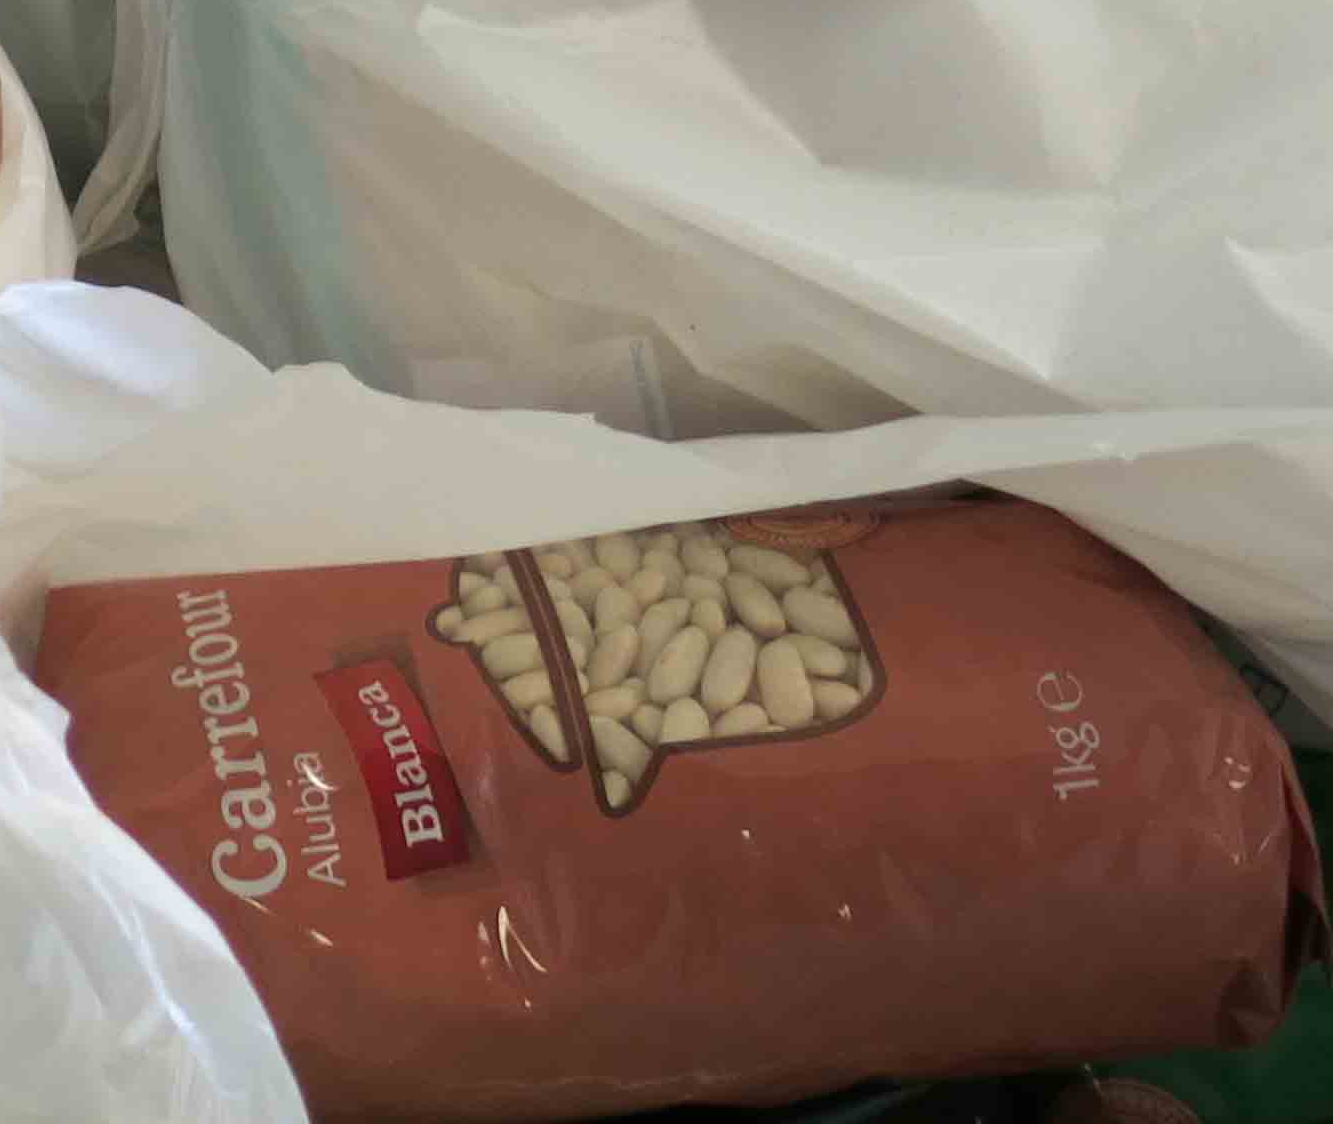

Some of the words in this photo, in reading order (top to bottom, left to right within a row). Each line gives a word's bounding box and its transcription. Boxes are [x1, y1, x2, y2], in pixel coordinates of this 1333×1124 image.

[171, 588, 289, 898] Carrefour
[296, 750, 347, 889] Alubia
[359, 679, 445, 849] Blanca
[1052, 721, 1101, 804] 1kg
